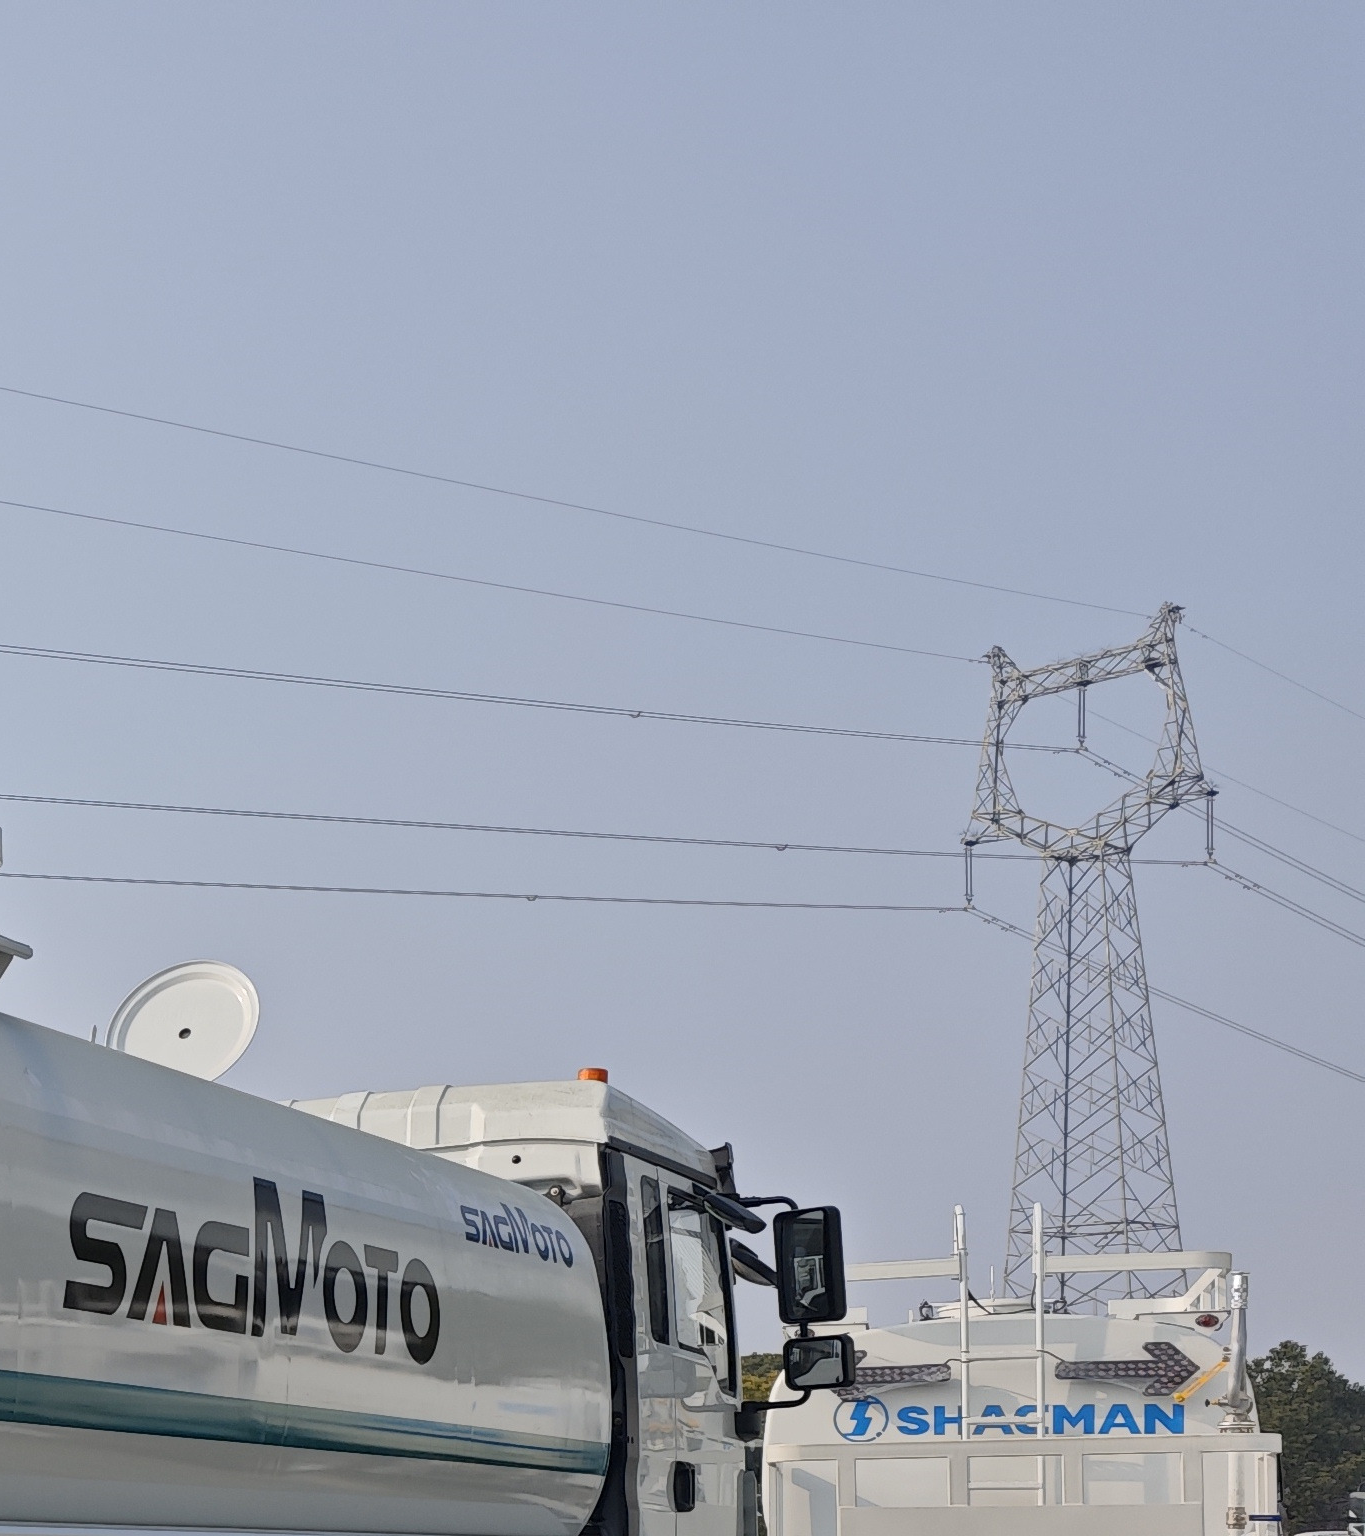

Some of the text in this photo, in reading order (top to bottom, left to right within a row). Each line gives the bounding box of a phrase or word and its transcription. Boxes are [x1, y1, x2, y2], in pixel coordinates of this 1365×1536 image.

[460, 1202, 574, 1268] SAGMOTO
[63, 1176, 440, 1365] SAGMOTO
[896, 1403, 1185, 1436] SHACMAN
